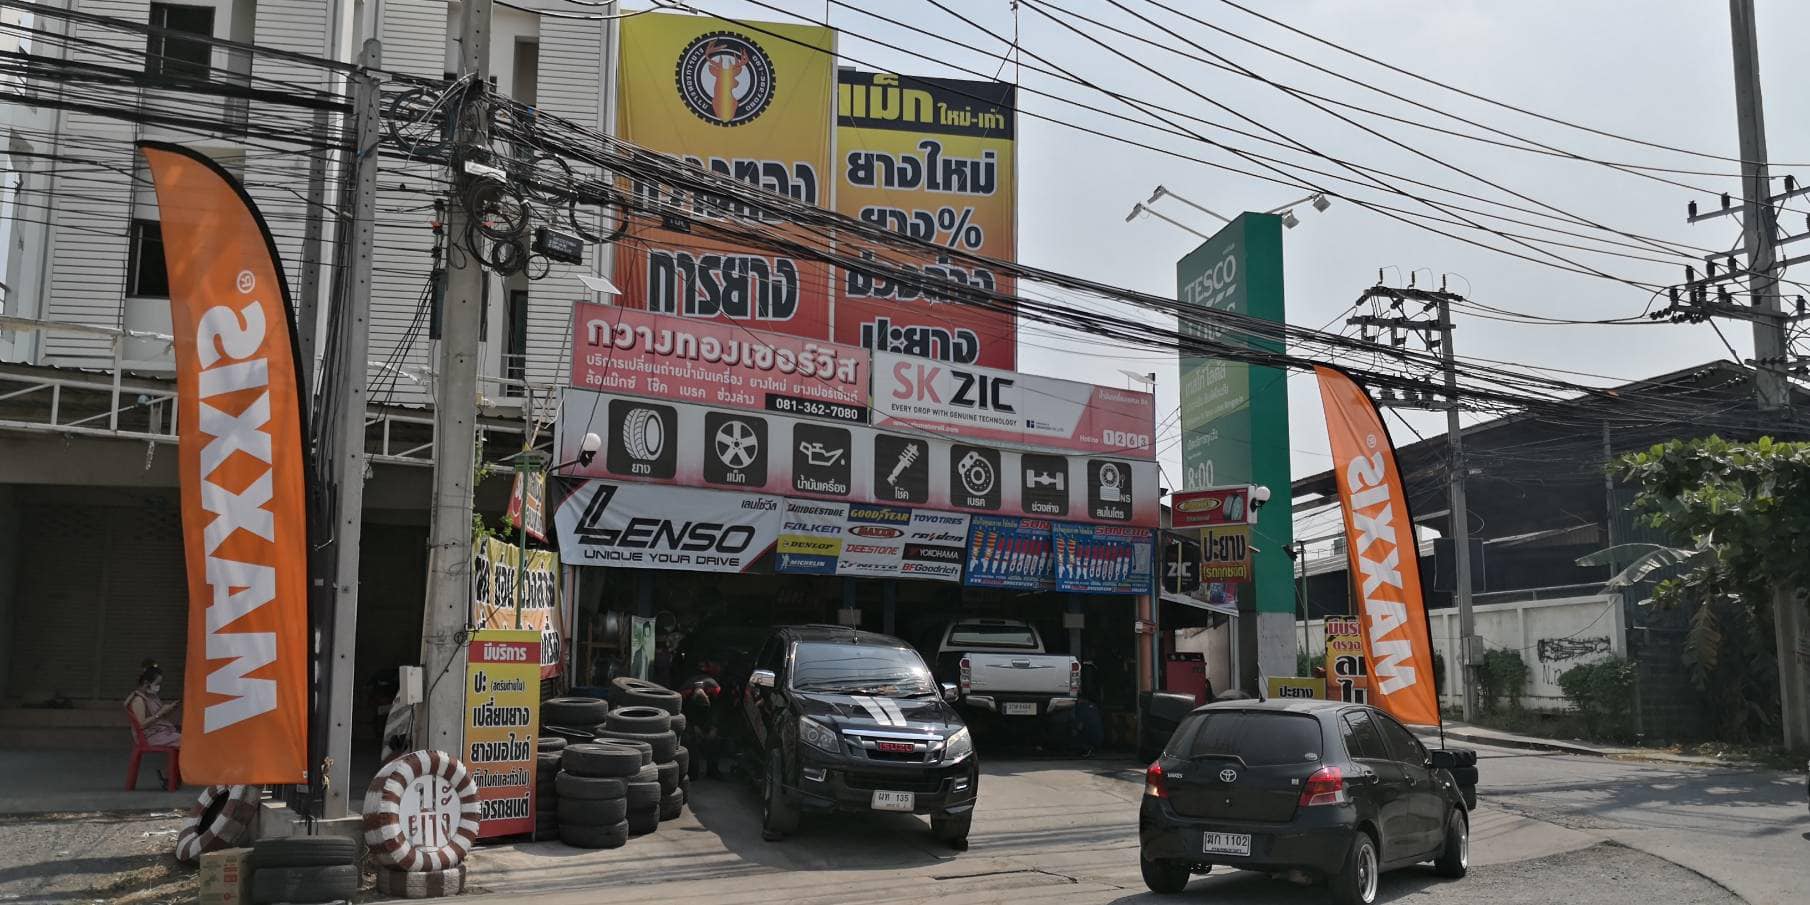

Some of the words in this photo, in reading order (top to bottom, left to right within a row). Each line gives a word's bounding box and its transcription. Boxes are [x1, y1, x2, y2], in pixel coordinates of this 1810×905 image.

[838, 74, 934, 123] แม็ก
[937, 102, 1005, 129] ใหม่-เก่า
[846, 140, 997, 195] ยางใหม่
[649, 249, 800, 321] การยาง
[1184, 255, 1236, 303] TESCO
[750, 377, 787, 391] ยางใหม่
[892, 361, 942, 404] SK
[949, 369, 1017, 414] ZIC
[680, 386, 706, 399] เบรค
[717, 387, 755, 404] ช่วงล่าง
[776, 398, 858, 420] 081-362-7080
[891, 403, 911, 413] EVERY
[914, 406, 931, 415] DROP
[932, 408, 948, 417] WITH
[950, 411, 977, 421] GENUINE
[979, 415, 1017, 426] TECHNOLOGY
[1105, 432, 1146, 447] 1263
[632, 463, 651, 475] ยาง
[726, 470, 745, 484] แม็ก
[1188, 460, 1214, 489] 8:00
[797, 475, 846, 493] น้ำมันเครื่อง
[787, 504, 845, 517] BRIDGESTONE
[967, 497, 986, 507] เบรค
[1032, 502, 1059, 513] ช่วงล่าง
[574, 484, 756, 553] LENSO
[850, 508, 910, 521] GOODYEAR
[783, 522, 842, 534] FALKEN
[790, 541, 834, 550] DUNLOP
[919, 549, 959, 559] YOKOHAMA
[1204, 530, 1246, 561] ปะยาง
[584, 549, 643, 562] UNIQUE
[649, 552, 693, 564] YOUR
[696, 555, 740, 567] DRIVE
[790, 559, 826, 567] MICHELIN
[902, 563, 958, 575] BFGoodrich
[483, 643, 527, 660] มีบริการ
[474, 671, 486, 693] ปะ
[1279, 685, 1314, 698] ปะยาง
[473, 697, 530, 727] เปลี่ยนยาง
[471, 733, 531, 762] ยางมอไซค์
[896, 794, 909, 802] 135
[1226, 835, 1248, 847] 1102
